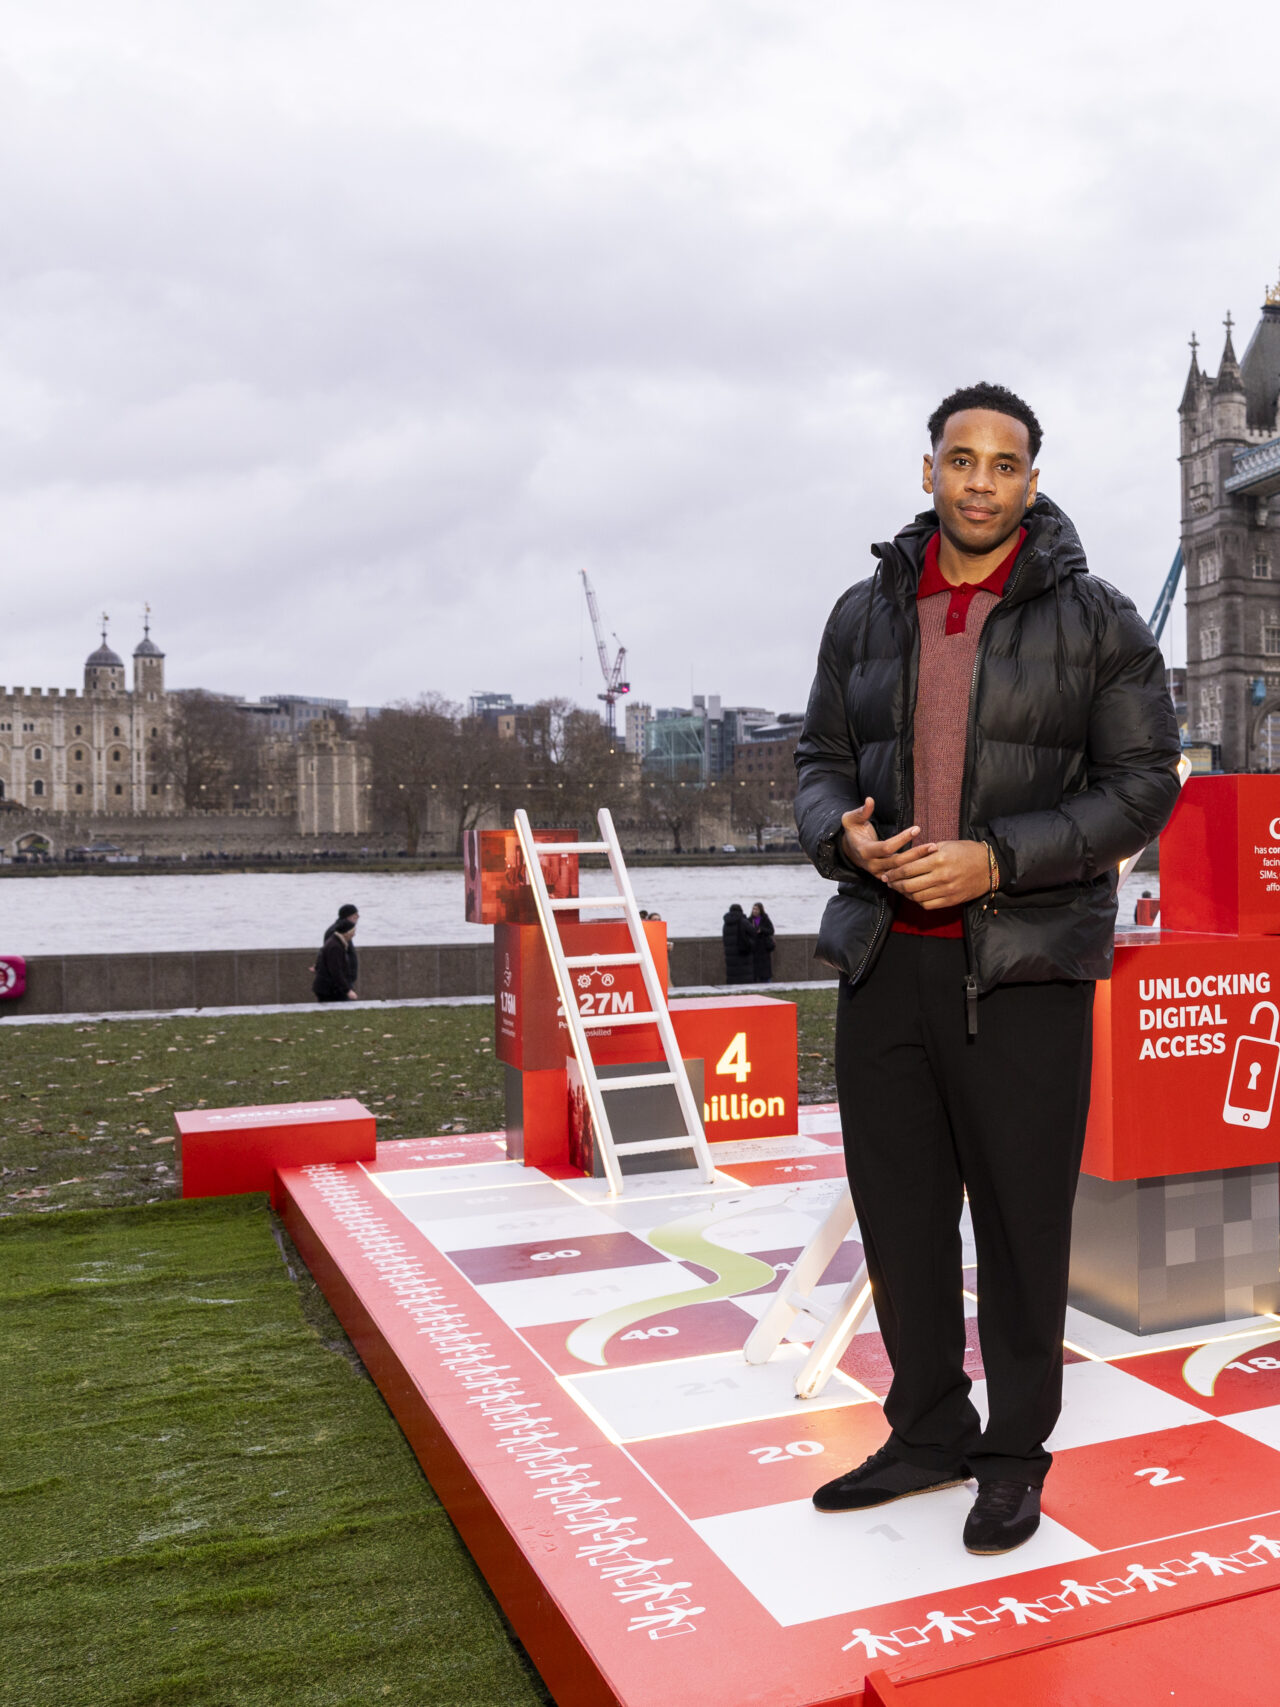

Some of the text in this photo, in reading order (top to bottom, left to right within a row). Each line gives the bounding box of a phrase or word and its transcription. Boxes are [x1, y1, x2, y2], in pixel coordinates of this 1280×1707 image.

[1254, 846, 1267, 854] has
[1259, 870, 1279, 880] SIMs,
[1139, 972, 1271, 1001] UNLOCKING
[1139, 1004, 1228, 1031] DIGITAL
[584, 1028, 612, 1037] pskilled
[1139, 1032, 1227, 1061] ACCESS
[716, 1032, 752, 1084] 4
[530, 1249, 582, 1263] 60
[619, 1325, 680, 1342] 40
[675, 1376, 741, 1397] 21
[747, 1440, 825, 1465] 20
[1133, 1466, 1186, 1488] 2
[863, 1523, 906, 1543] 1
